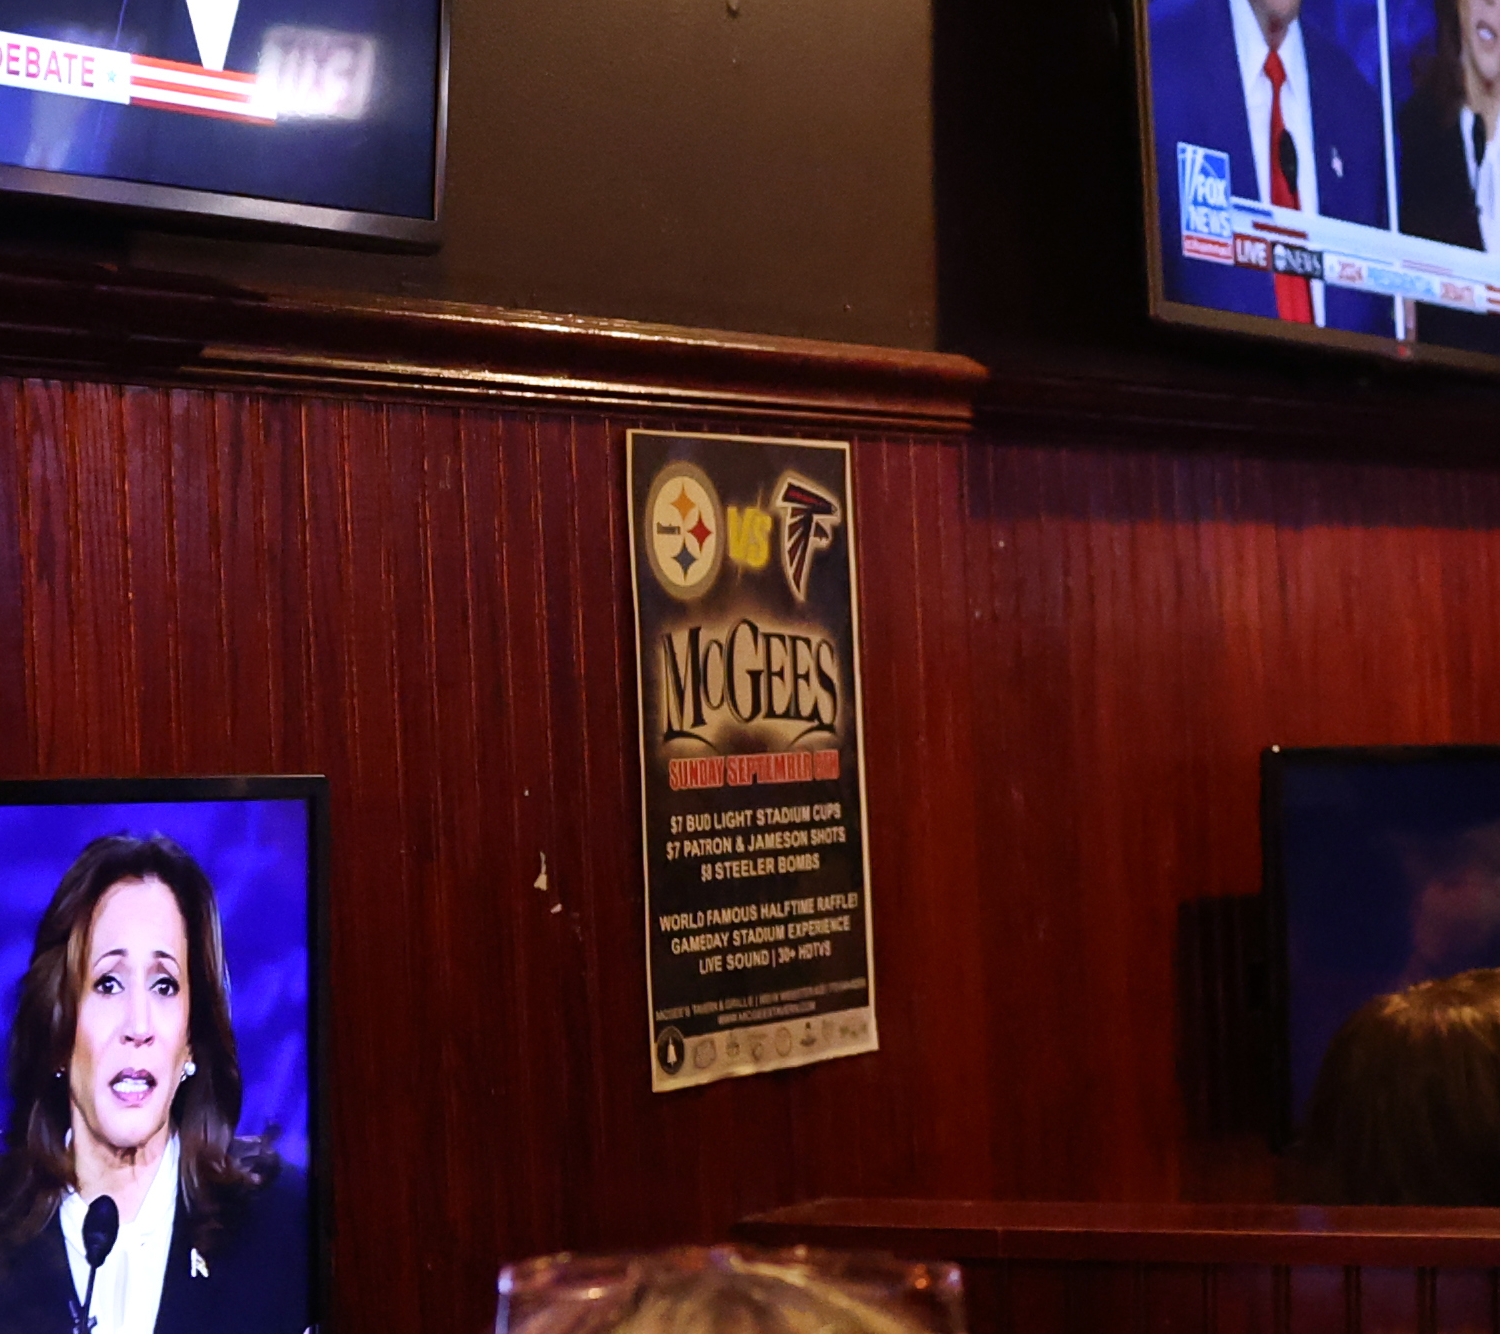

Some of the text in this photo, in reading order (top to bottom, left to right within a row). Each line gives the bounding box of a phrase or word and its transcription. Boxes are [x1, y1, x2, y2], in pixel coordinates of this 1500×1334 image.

[1235, 238, 1268, 267] LIVE
[727, 506, 773, 568] VS
[669, 756, 725, 791] SUNDAY
[670, 801, 841, 834] $7 BUD LIGHT STADIUM CUPS
[666, 826, 846, 860] $7 PATRON & JAMESON SHOTS
[714, 857, 776, 880] STEELER
[778, 853, 821, 873] BOMBS
[659, 911, 705, 932] WORLD
[706, 903, 758, 926] FAMOUS
[760, 897, 815, 919] HALFTIME
[671, 915, 850, 955] GAMEDAY STADIUM EXPERIENCE
[699, 955, 723, 975] LIVE
[725, 949, 770, 972] SOUND
